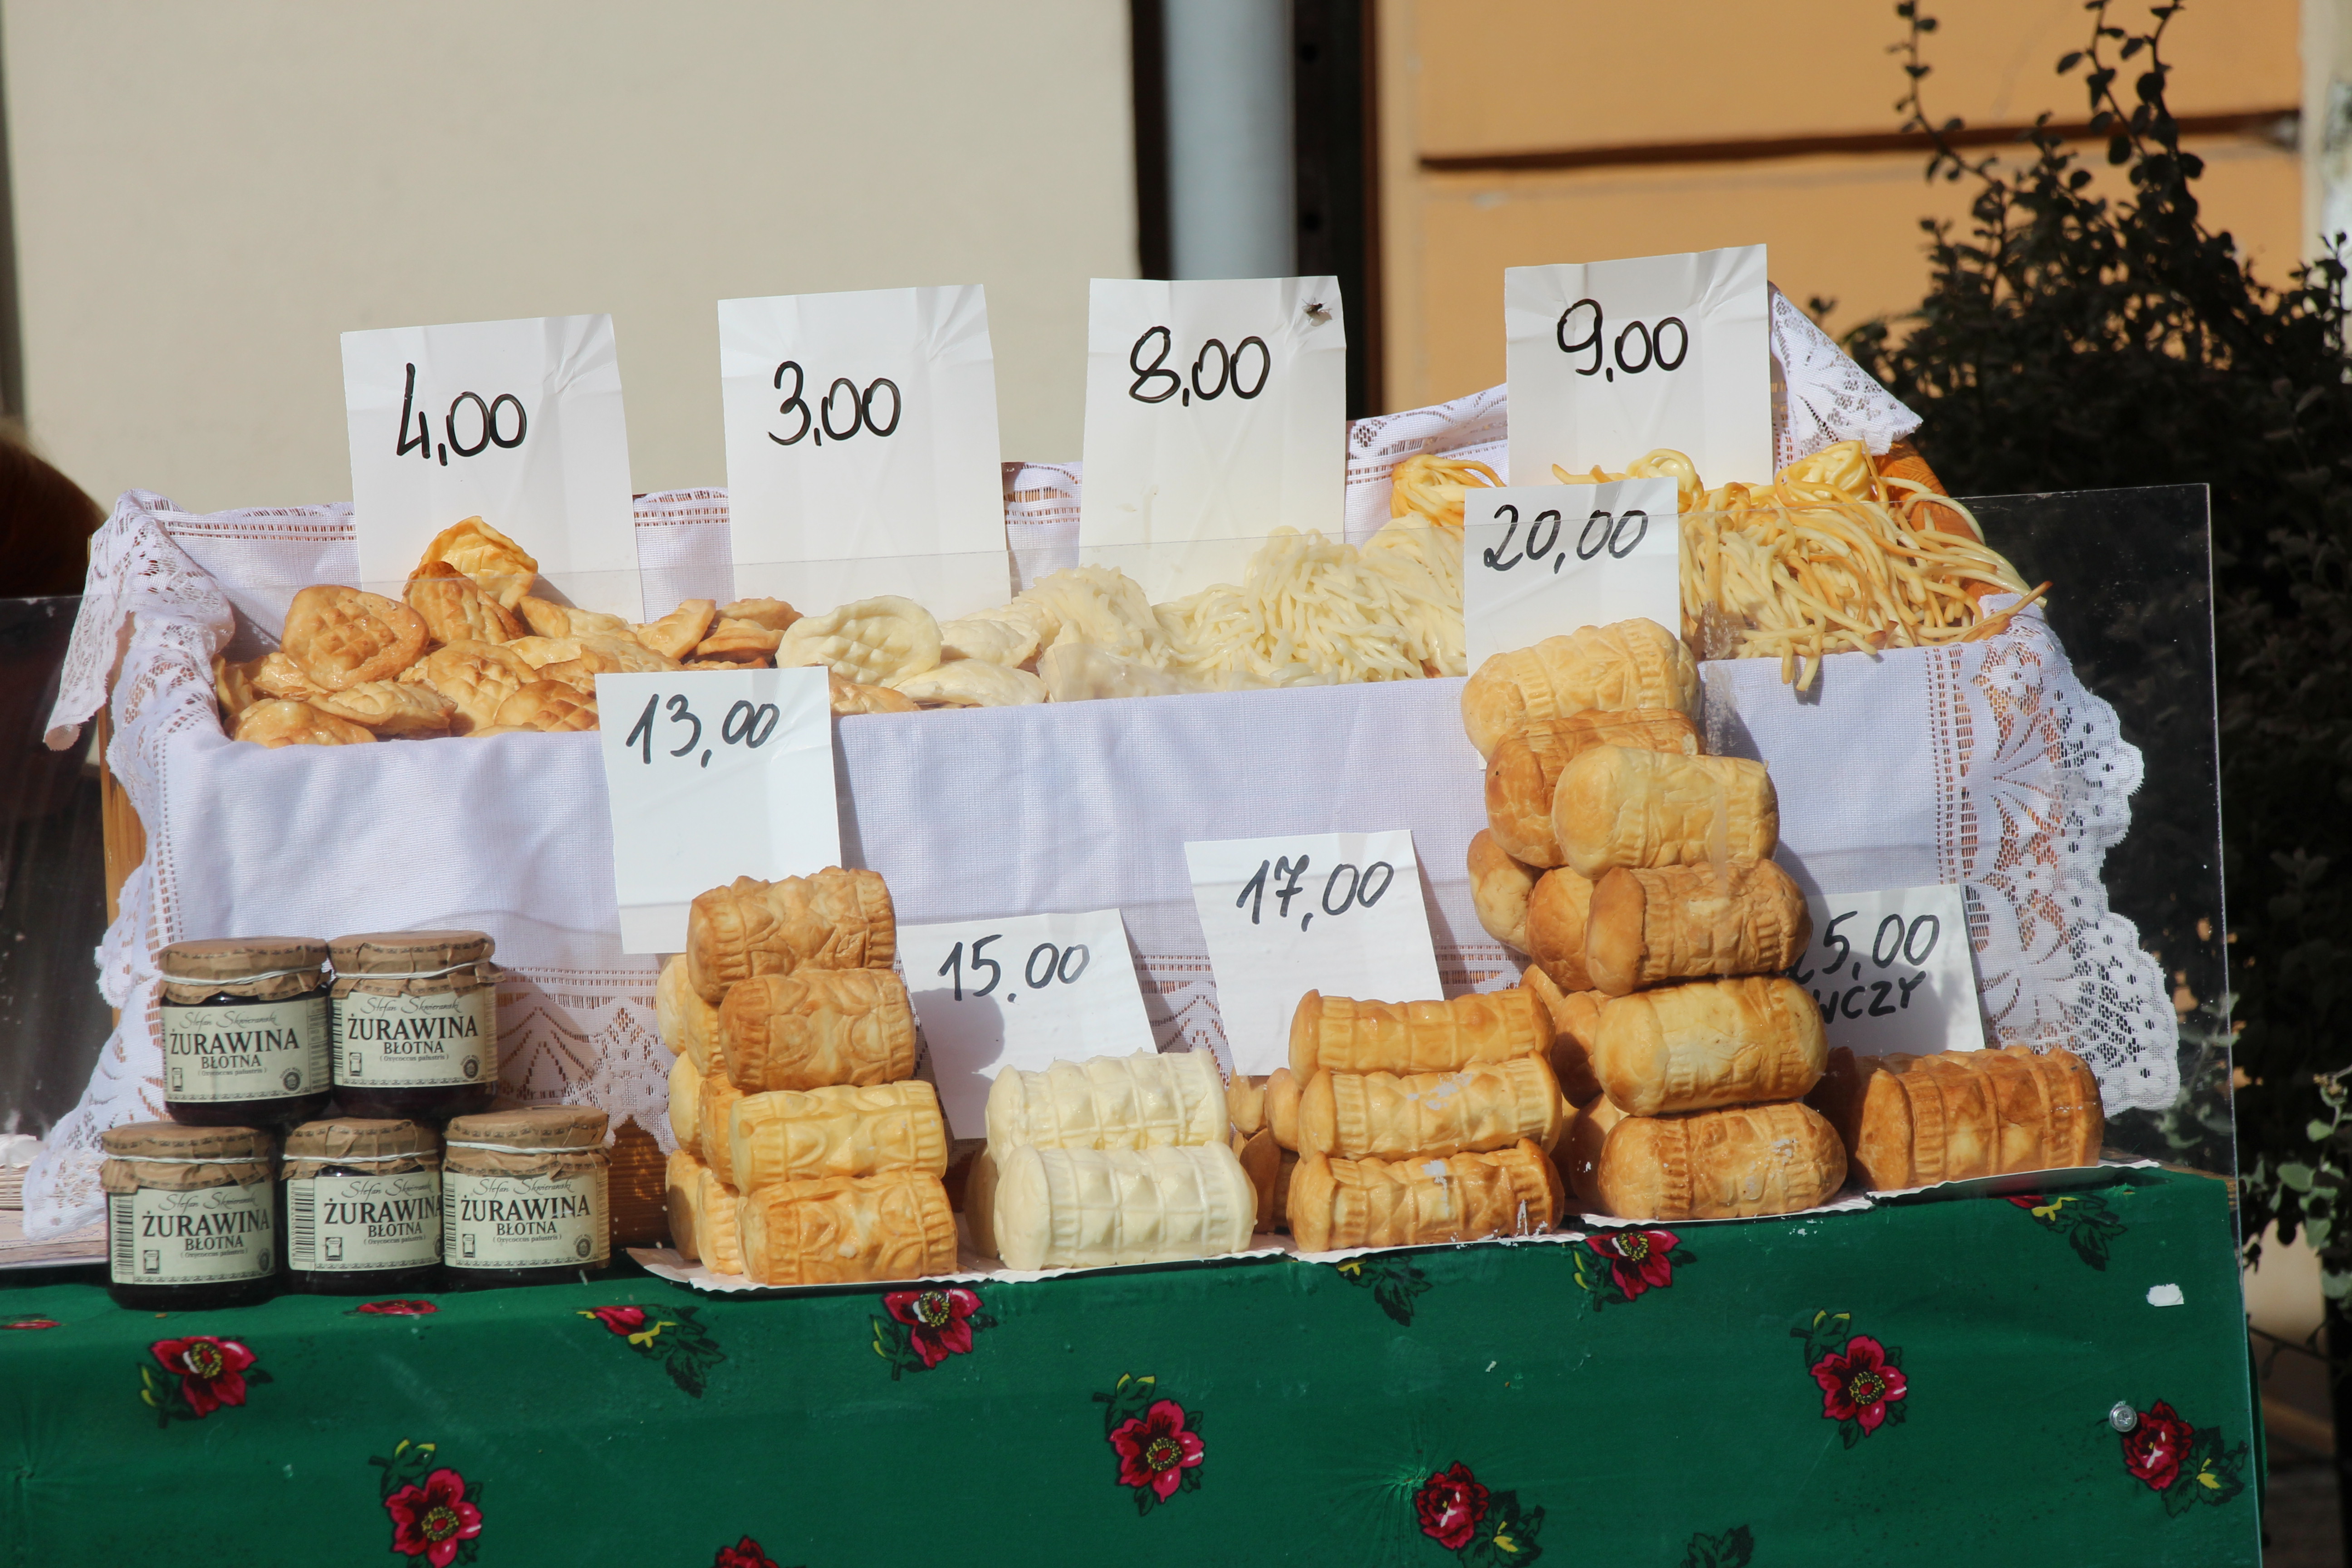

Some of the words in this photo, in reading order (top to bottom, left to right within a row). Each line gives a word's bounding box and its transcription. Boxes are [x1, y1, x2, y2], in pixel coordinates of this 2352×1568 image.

[1557, 298, 1688, 382] 9,00
[1129, 325, 1271, 407] 8,00
[396, 362, 527, 466] 4,00
[768, 361, 901, 446] 3,00
[1483, 504, 1648, 574] 20,00
[625, 693, 780, 768] 13,00
[1236, 854, 1394, 932] 17,00
[347, 1013, 479, 1041] ŻURAWINA
[170, 1028, 300, 1056] ŻURAWINA
[383, 1040, 445, 1055] BŁOTNA
[201, 1054, 261, 1069] BŁOTNA
[473, 1178, 510, 1200] Stefan
[142, 1208, 270, 1238] ŻURAWINA
[460, 1194, 591, 1223] ŻURAWINA
[184, 1235, 244, 1251] BŁOTNA
[368, 1222, 423, 1238] BŁOTNA
[496, 1221, 558, 1236] BŁOTNA
